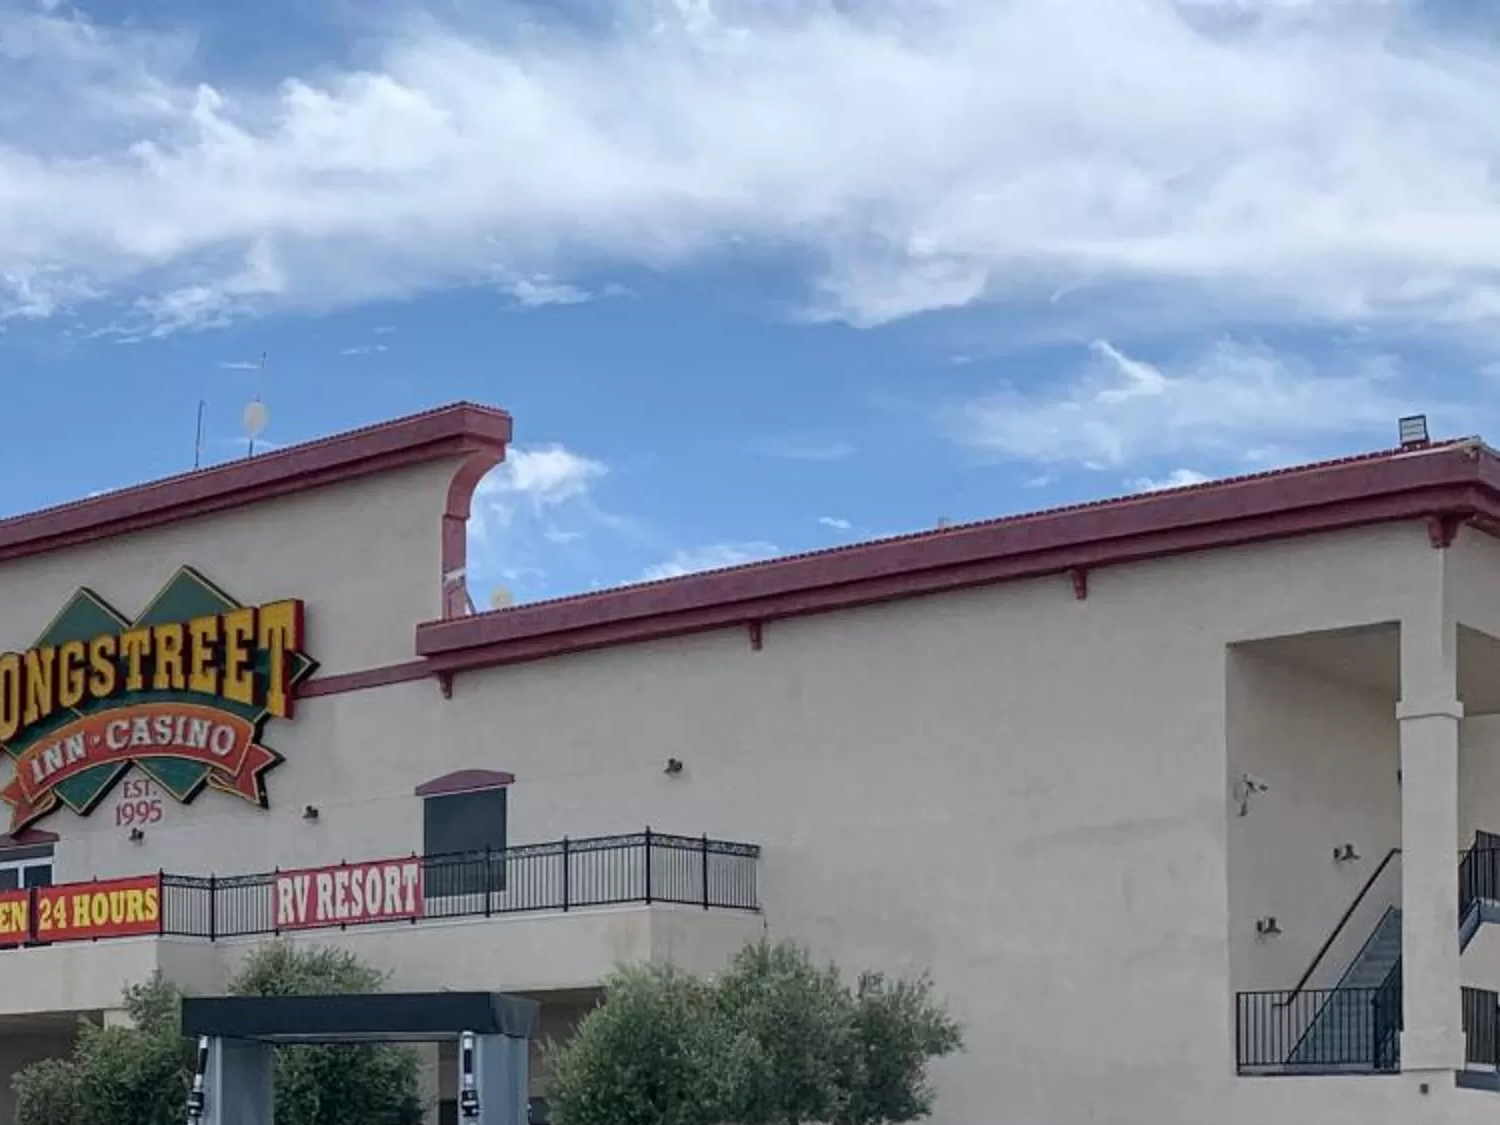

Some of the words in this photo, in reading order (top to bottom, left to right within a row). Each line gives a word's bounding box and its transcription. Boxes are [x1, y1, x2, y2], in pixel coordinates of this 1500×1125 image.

[31, 731, 87, 782] INN
[105, 715, 236, 757] CASINO
[122, 779, 158, 799] EST.
[114, 800, 164, 827] 1995
[38, 896, 68, 931] 24
[72, 887, 161, 927] HOURS
[276, 876, 312, 925] RV
[316, 862, 420, 921] RESORT
